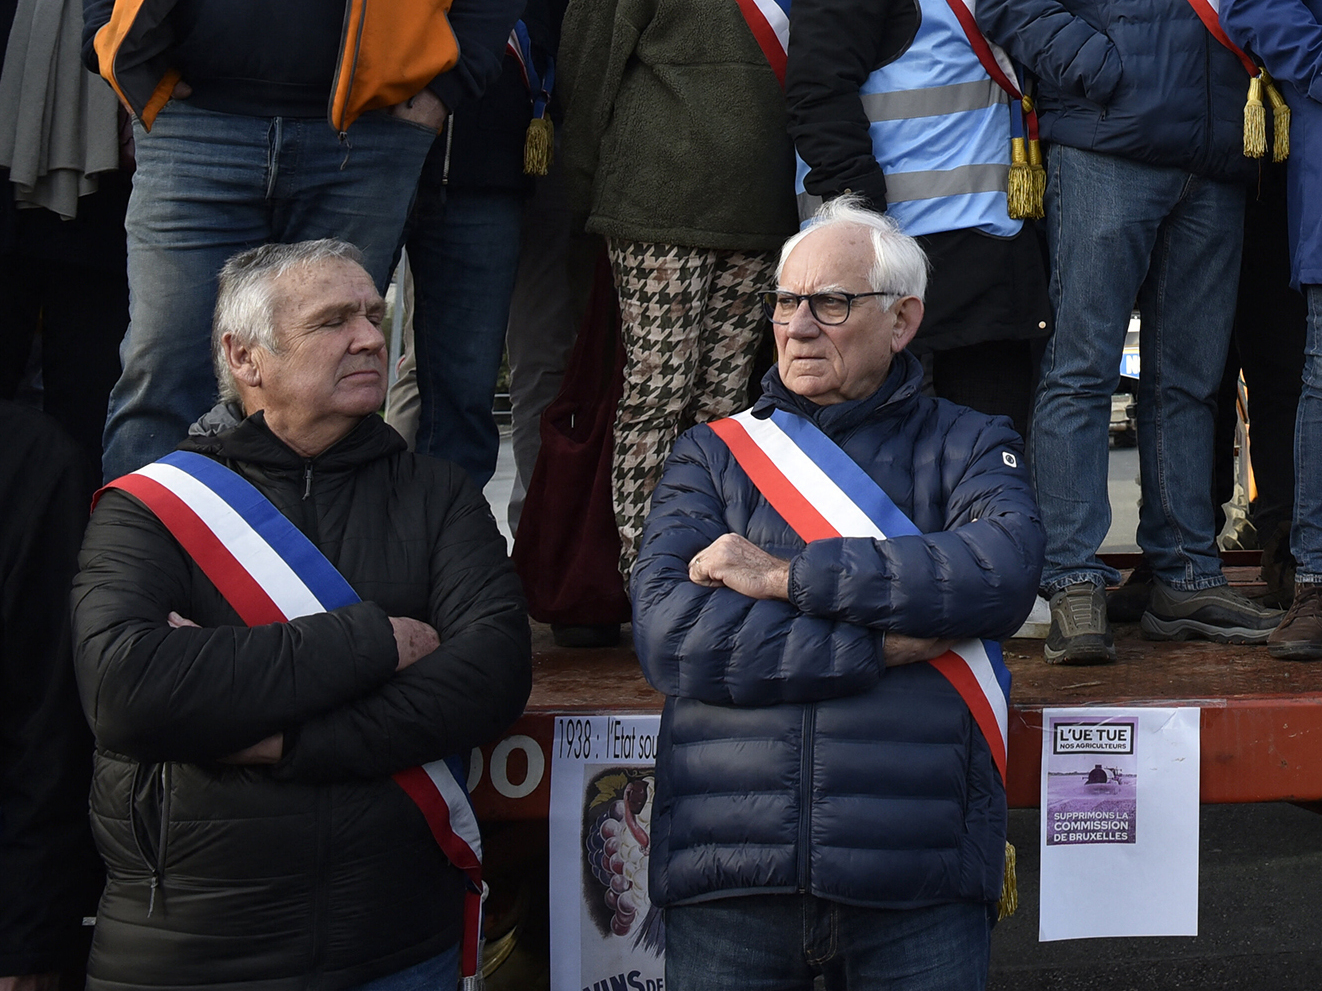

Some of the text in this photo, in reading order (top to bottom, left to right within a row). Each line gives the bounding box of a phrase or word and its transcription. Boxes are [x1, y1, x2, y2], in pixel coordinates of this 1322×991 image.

[559, 719, 591, 759] 1938
[606, 716, 636, 759] l'Etat
[1060, 730, 1127, 741] L'UE TUE
[1054, 812, 1115, 820] SUPPRIMONS
[1054, 821, 1129, 831] COMMISSION
[1054, 832, 1128, 842] DE BRUXELLES
